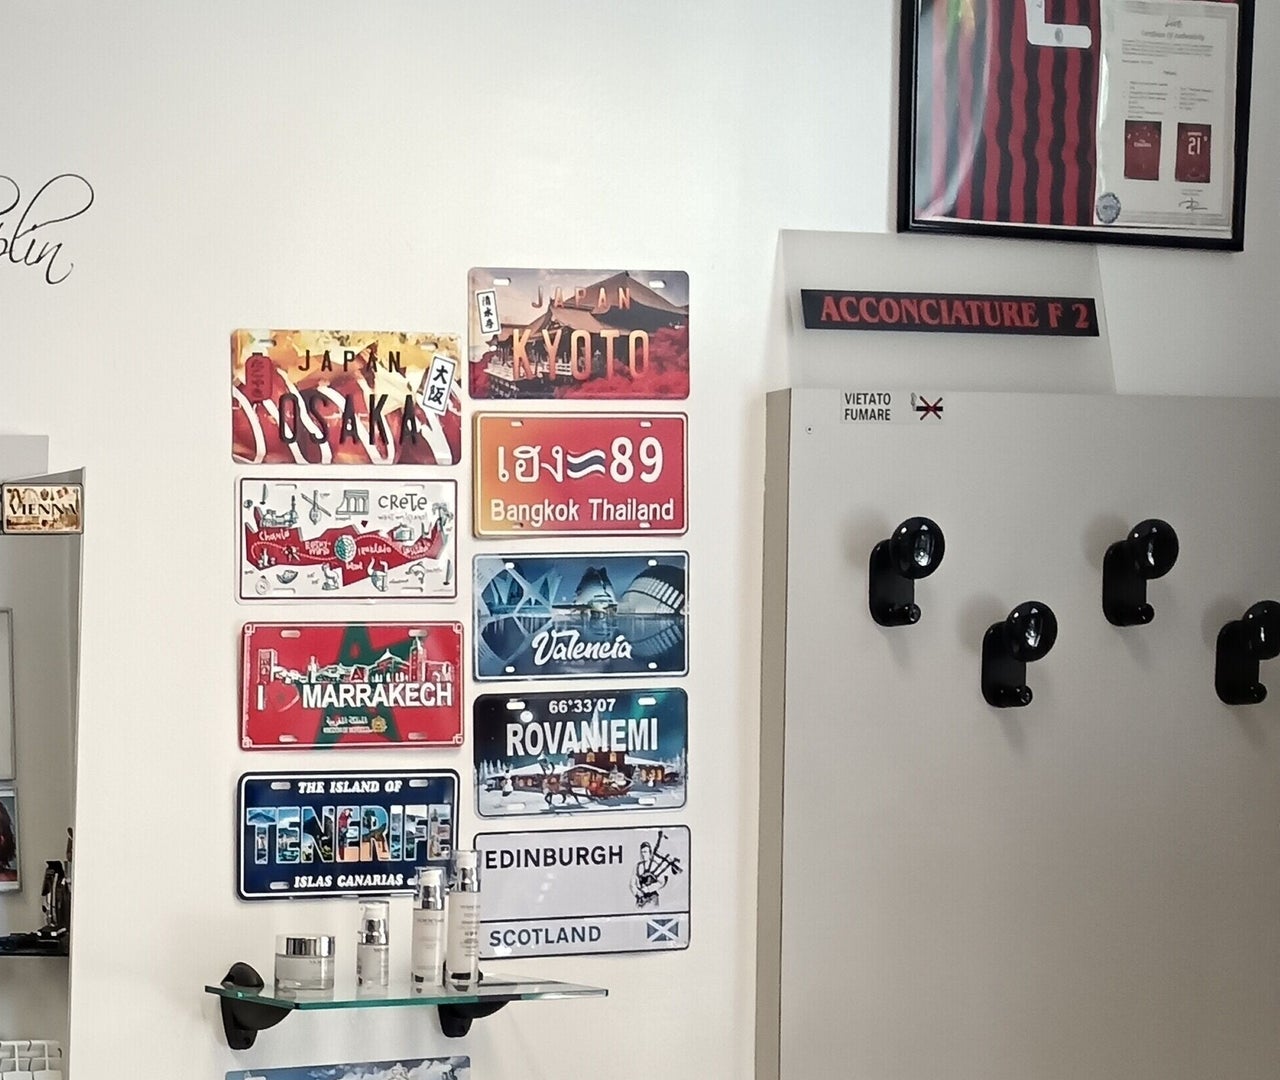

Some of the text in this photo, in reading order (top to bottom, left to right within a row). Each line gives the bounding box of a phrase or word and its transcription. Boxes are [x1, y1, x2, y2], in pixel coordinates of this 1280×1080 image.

[532, 286, 631, 310] JAPAN
[821, 296, 1089, 328] ACCONCIATURE F 2
[298, 350, 402, 373] JAPAN
[512, 329, 650, 381] KYOTO
[427, 365, 448, 405] 大阪
[844, 392, 891, 405] VIETATO
[279, 394, 419, 445] OSAKA
[844, 408, 891, 421] FUMARE
[610, 436, 664, 483] 89
[10, 504, 77, 515] VIENNA
[491, 498, 674, 527] Bangkok Thailand
[532, 629, 633, 666] Valencia
[302, 683, 452, 708] MARRAKECH
[506, 718, 658, 757] ROVANIEMI
[298, 781, 402, 794] THE ISLAND OF
[246, 805, 452, 864] TENERIFE
[485, 845, 623, 869] EDINBURGH
[294, 874, 404, 888] ISLAS CANARIAS
[490, 926, 601, 947] SCOTLAND
